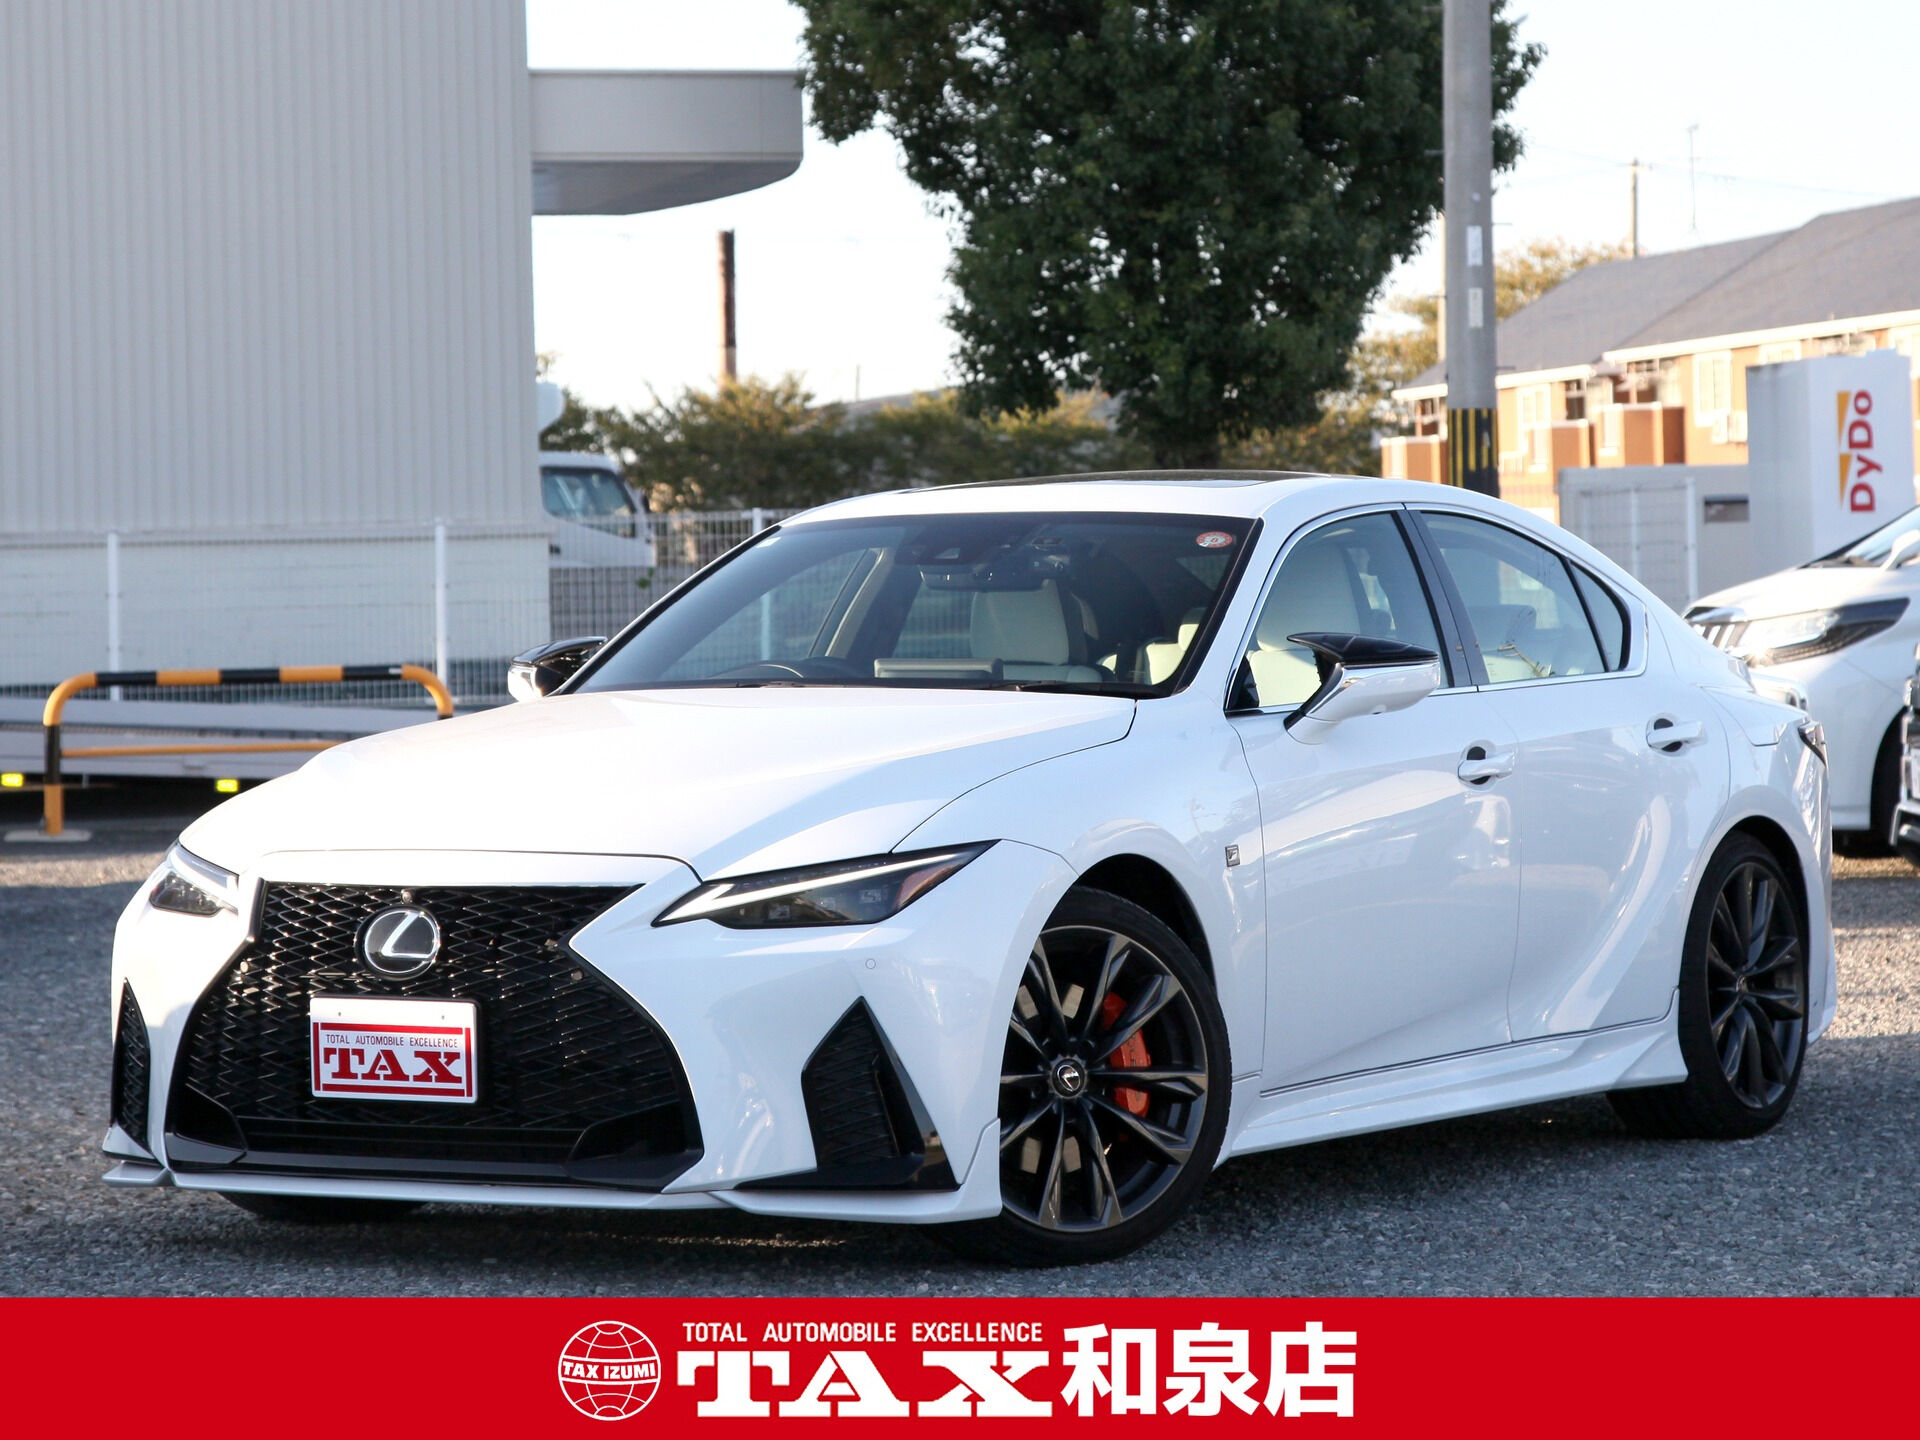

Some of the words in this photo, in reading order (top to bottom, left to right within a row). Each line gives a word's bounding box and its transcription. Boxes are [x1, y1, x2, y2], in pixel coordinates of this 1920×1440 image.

[1848, 389, 1883, 512] DyDo
[326, 1034, 350, 1045] TOTAL
[355, 1035, 404, 1047] AUTOMOBILE
[409, 1036, 458, 1049] EXCELLENCE
[323, 1047, 463, 1084] TAX
